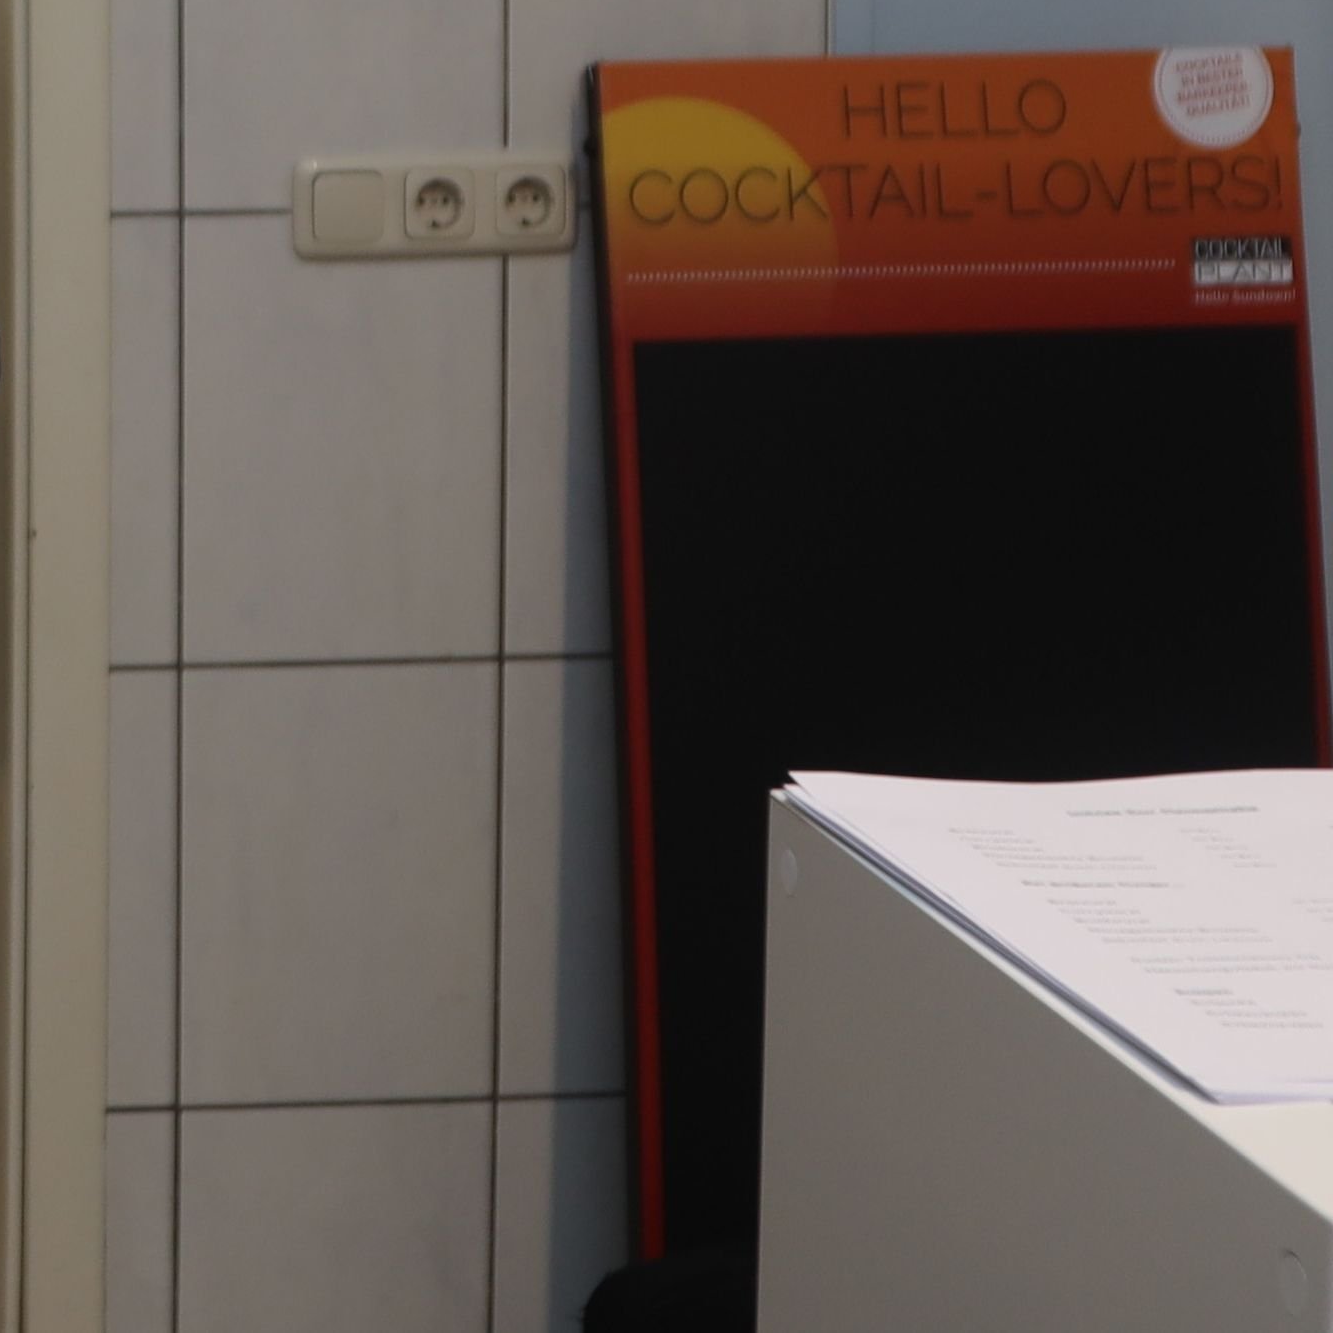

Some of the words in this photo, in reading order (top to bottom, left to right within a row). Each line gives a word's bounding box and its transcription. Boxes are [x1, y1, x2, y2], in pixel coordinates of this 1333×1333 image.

[842, 78, 1068, 141] HELLO
[628, 157, 1284, 228] COCKTAIL-LOVERS!
[1194, 237, 1290, 260] COCKTAIL
[1197, 261, 1292, 282] PLANT
